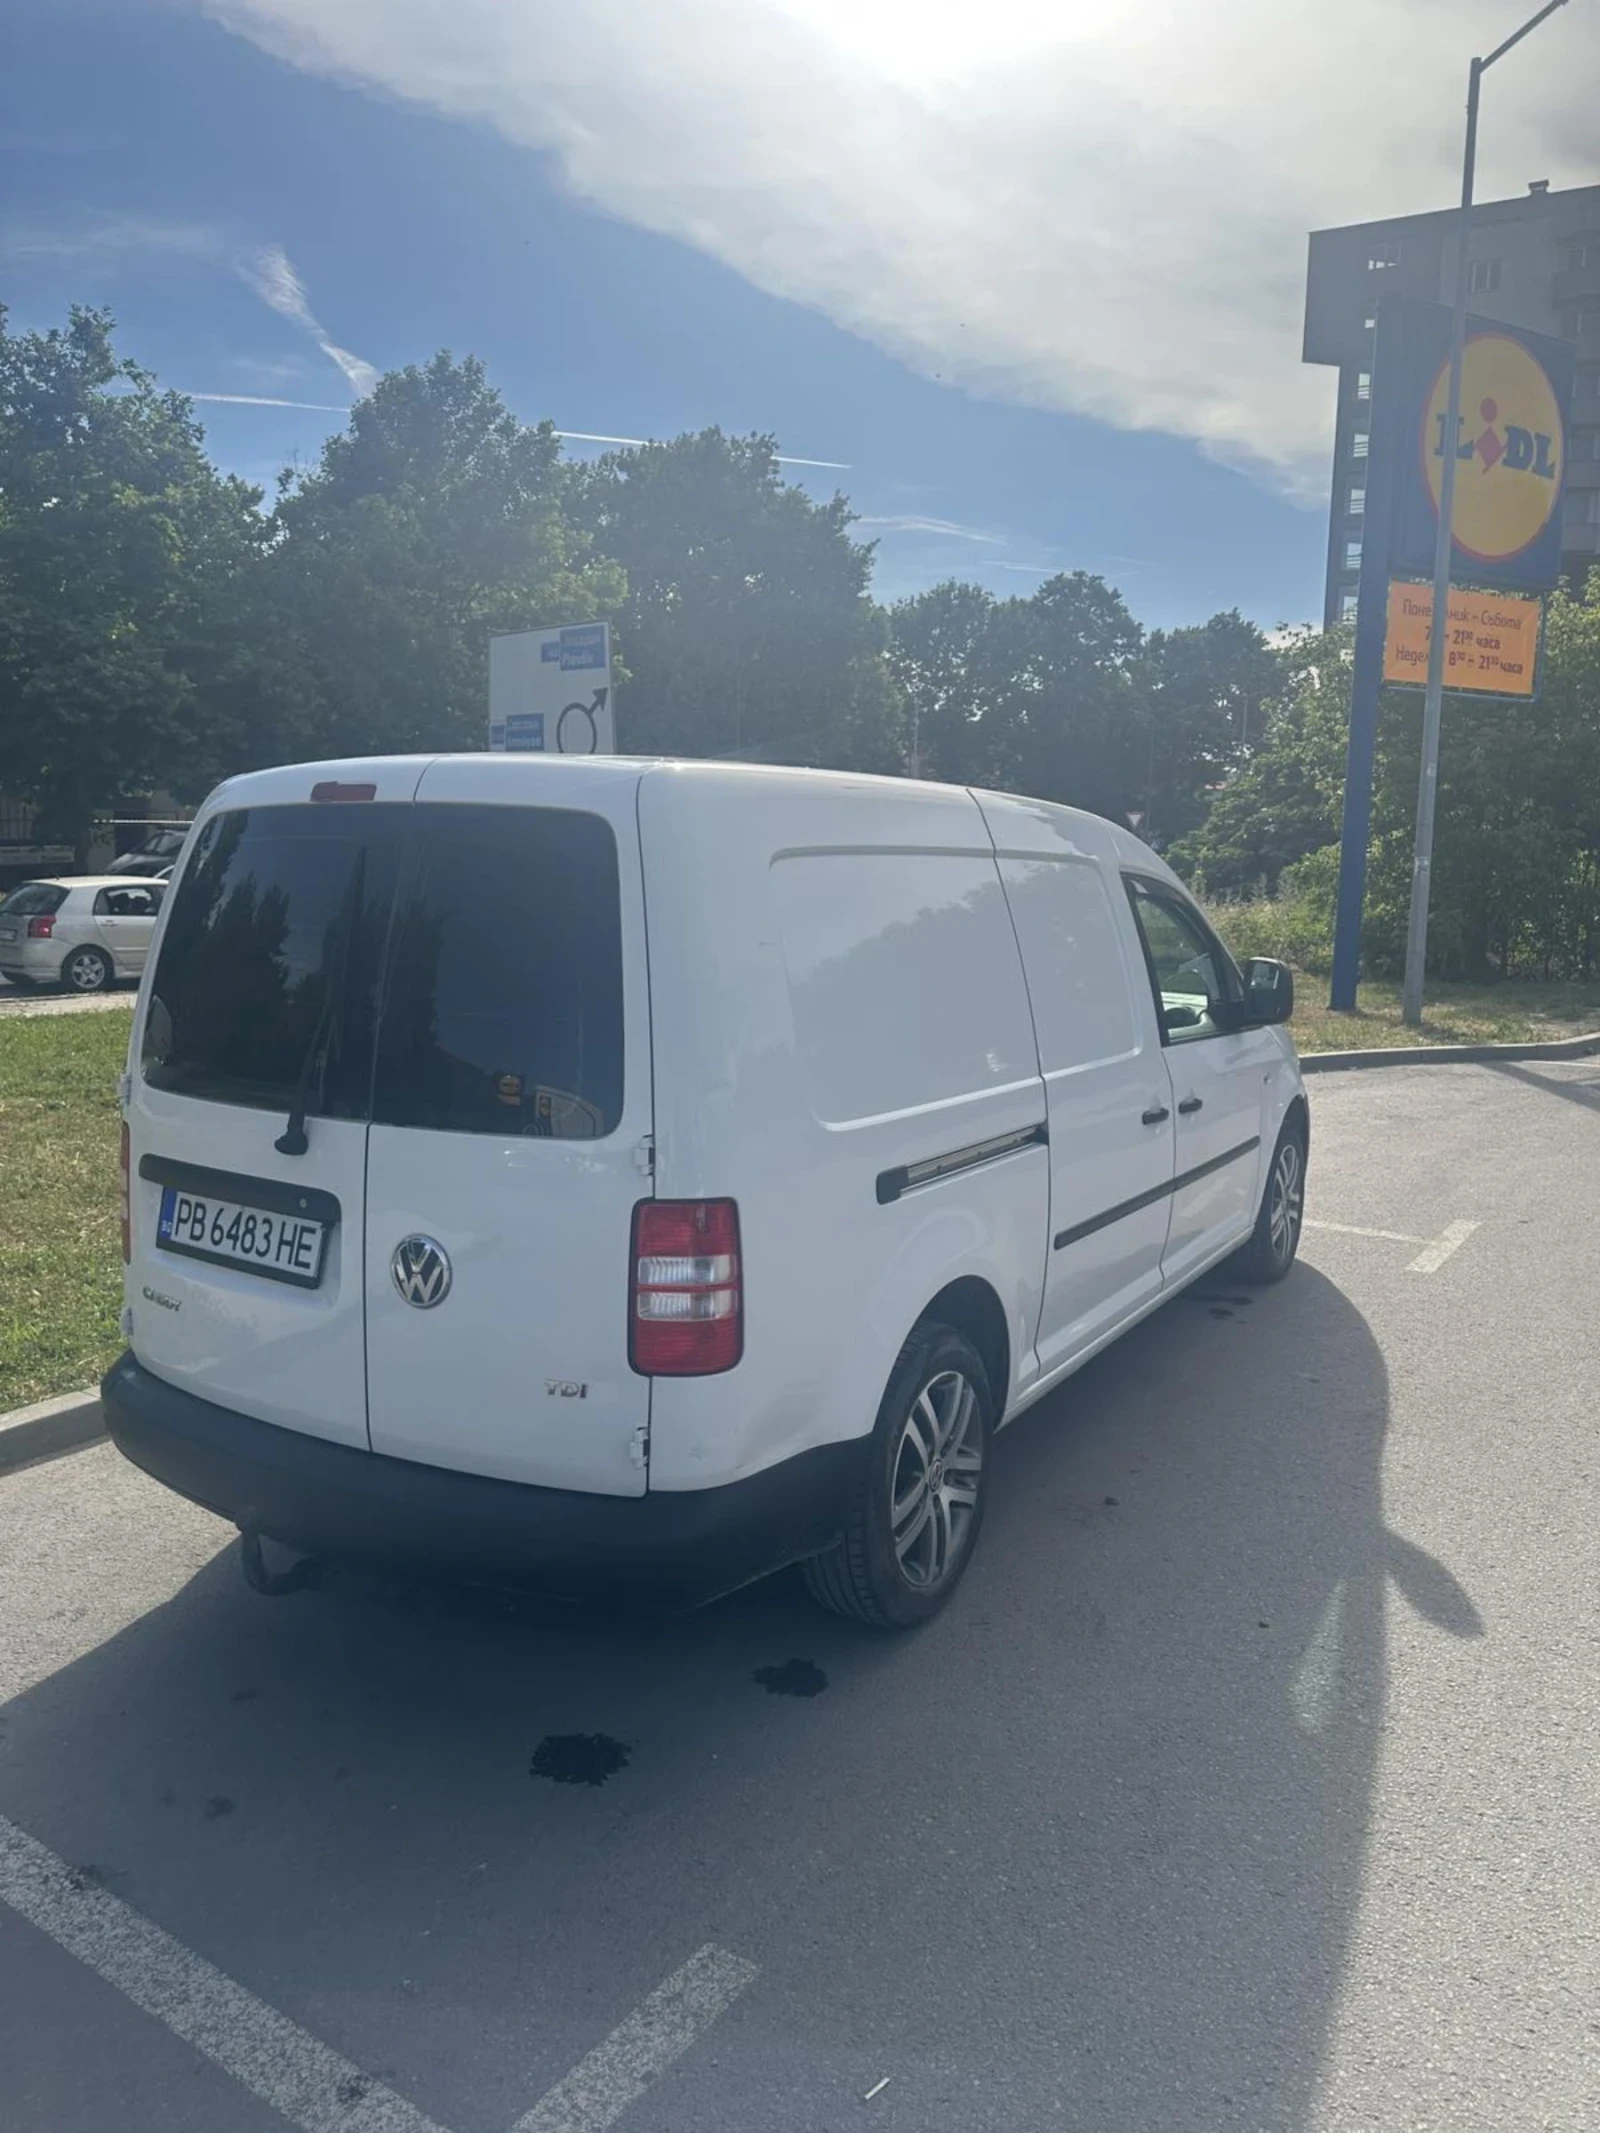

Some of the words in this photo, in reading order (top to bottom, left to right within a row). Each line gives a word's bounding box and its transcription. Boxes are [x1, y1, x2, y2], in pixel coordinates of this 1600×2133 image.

[1403, 598, 1469, 622] Поненик
[1480, 609, 1522, 630] Събота
[1476, 637, 1501, 650] часа
[1396, 644, 1429, 666] Неде
[1500, 661, 1524, 675] часа
[174, 1198, 207, 1242] PB
[210, 1207, 273, 1258] 6483
[275, 1221, 317, 1270] HE
[393, 1237, 449, 1307] VW
[543, 1378, 588, 1399] TDI
